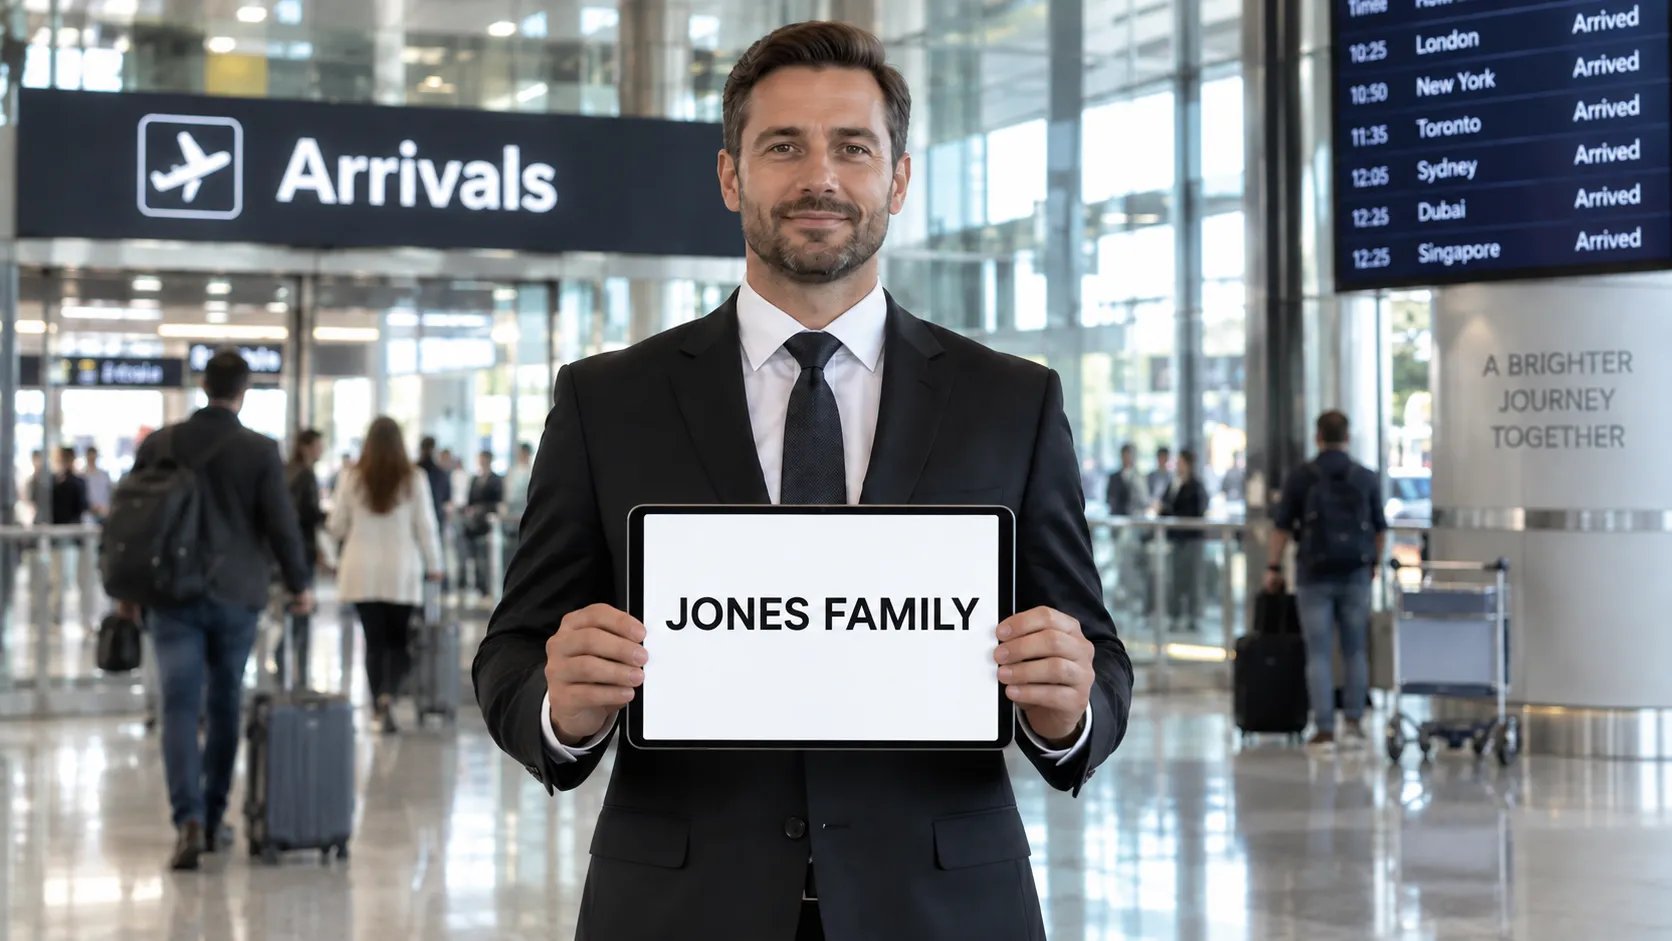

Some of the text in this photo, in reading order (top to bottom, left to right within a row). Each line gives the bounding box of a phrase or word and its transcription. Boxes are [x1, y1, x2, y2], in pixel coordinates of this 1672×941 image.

[1349, 4, 1640, 63] 10:25 London Arrived
[1350, 49, 1640, 105] 10:50 New York Arrived
[1351, 93, 1641, 147] 11:35 Toronto Arrived
[275, 137, 558, 213] Arrivals
[1351, 138, 1641, 188] 12:05 Sydney Arrived
[1352, 182, 1641, 228] 12:25 Dubai Arrived
[1352, 226, 1642, 269] 12:25 Singapore Arrived
[1482, 350, 1634, 378] A BRIGHTER
[1498, 387, 1616, 413] JOURNEY
[1490, 424, 1626, 449] TOGETHER
[665, 596, 980, 631] JONES FAMILY
